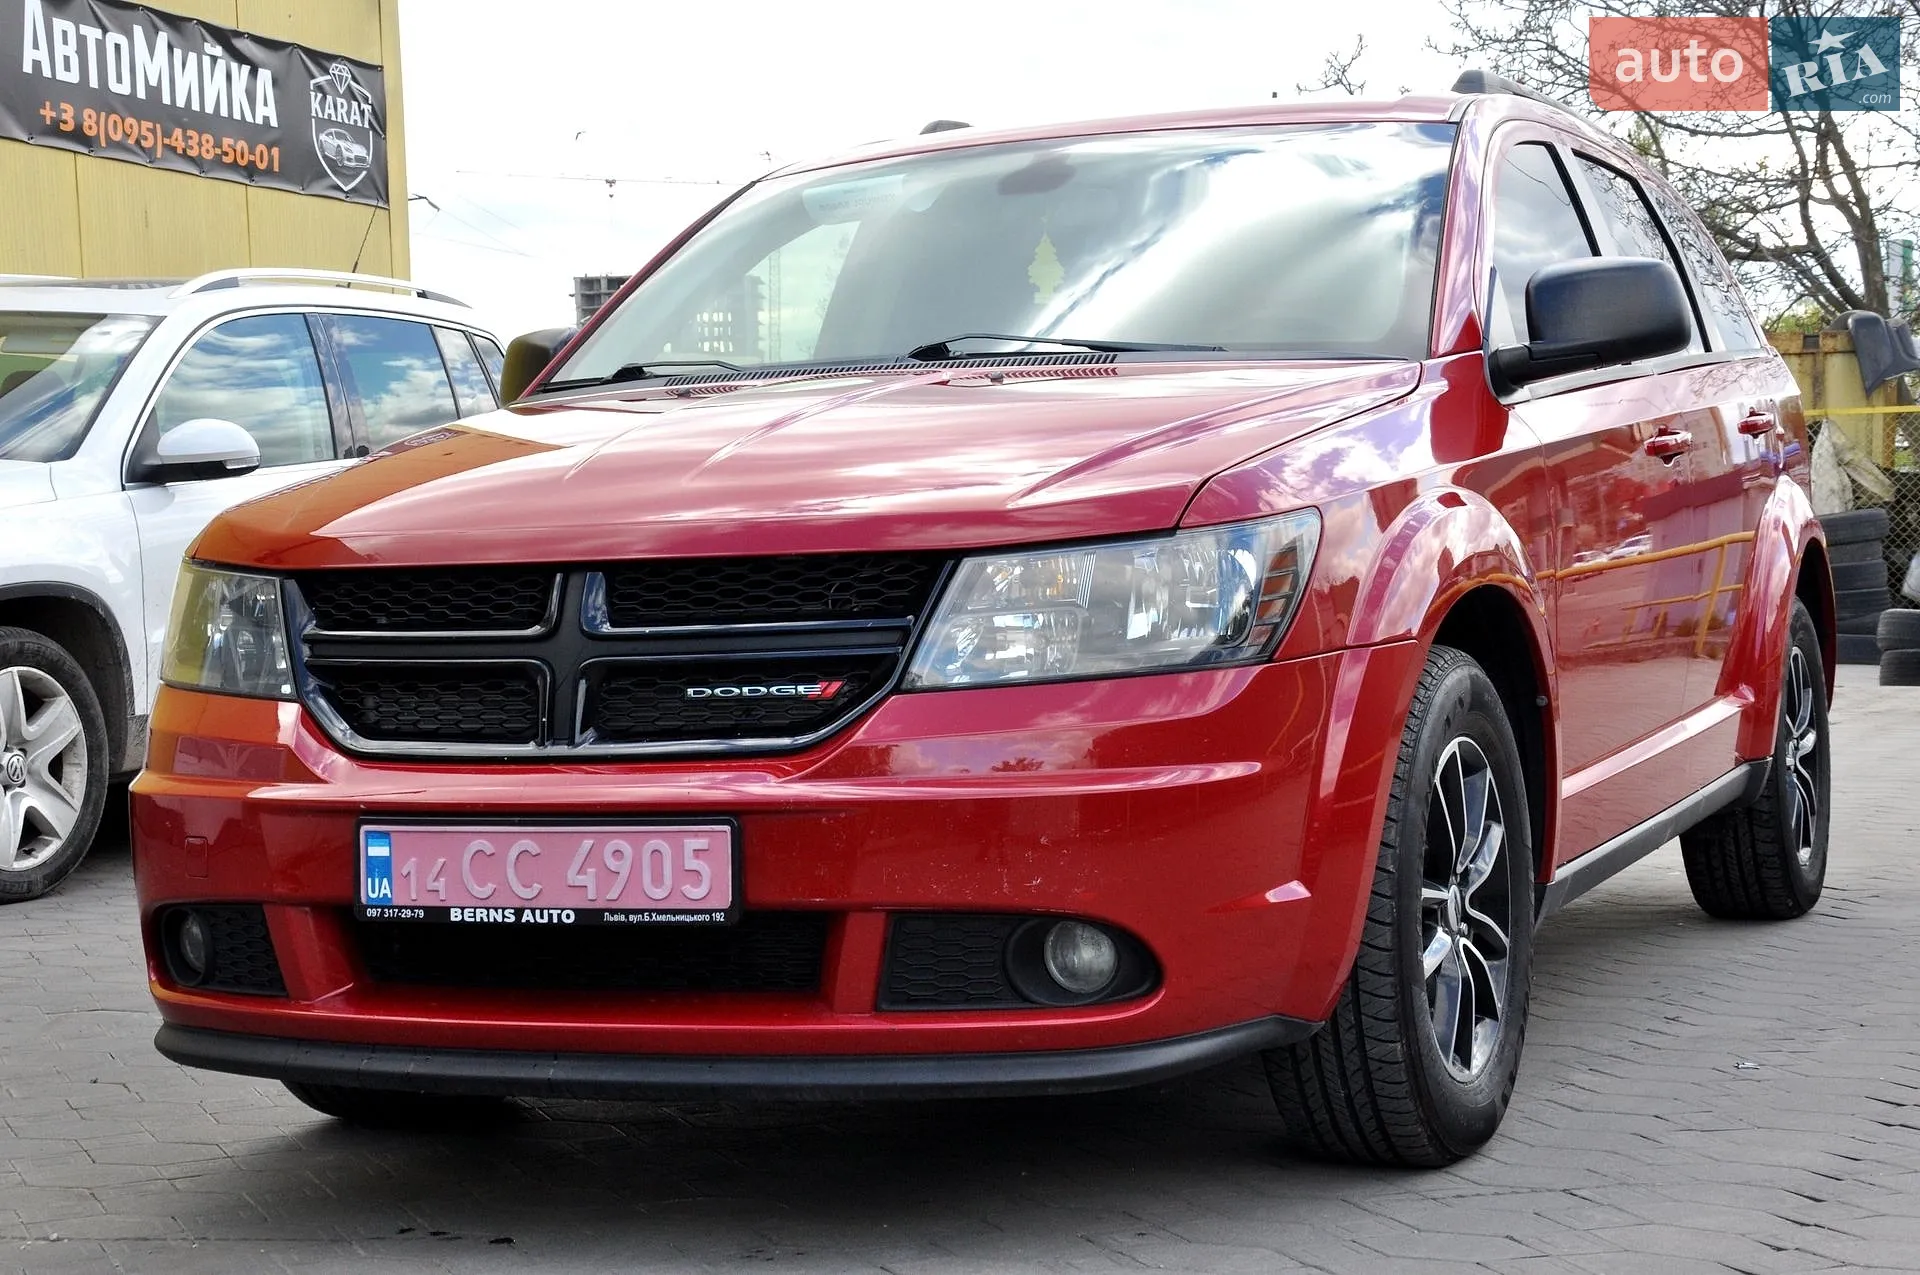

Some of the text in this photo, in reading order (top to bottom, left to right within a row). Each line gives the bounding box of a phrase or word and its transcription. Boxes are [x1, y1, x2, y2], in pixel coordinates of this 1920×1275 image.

[309, 91, 373, 129] KARAT
[687, 684, 822, 698] DODGE
[566, 839, 712, 901] 4905
[367, 879, 392, 899] UA
[366, 908, 425, 919] 097 317-29-79
[450, 908, 576, 924] BERNS AUTO
[711, 912, 725, 922] 192
